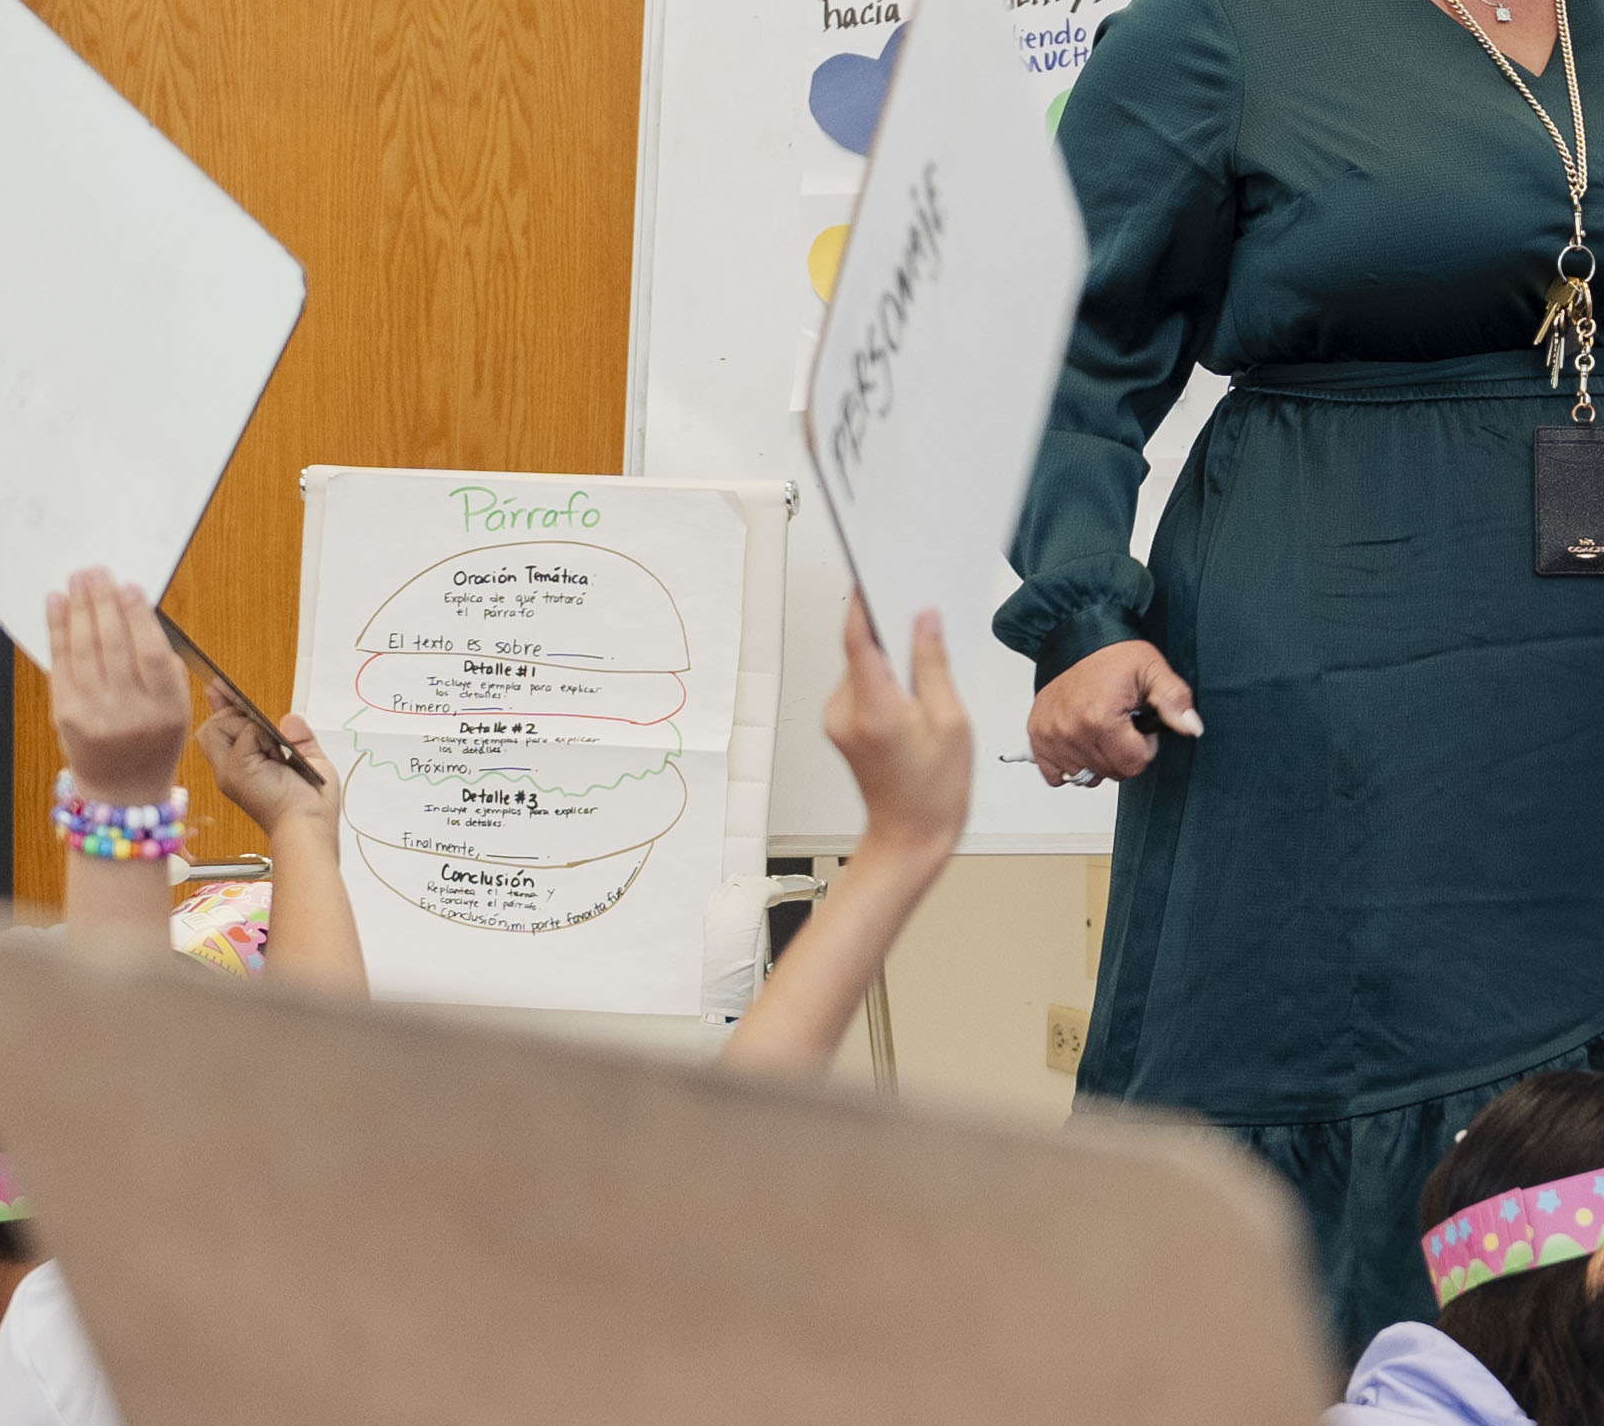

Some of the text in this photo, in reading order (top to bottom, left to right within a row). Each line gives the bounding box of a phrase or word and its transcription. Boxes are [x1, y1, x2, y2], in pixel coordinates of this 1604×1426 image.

[449, 485, 601, 533] Párrafo
[453, 567, 517, 587] Oración
[444, 592, 483, 607] Explica
[516, 590, 538, 610] qué
[484, 605, 534, 621] párrafo
[388, 634, 404, 650] El
[413, 634, 454, 652] texto
[495, 640, 542, 657] sobre
[464, 660, 512, 676] Detalle
[427, 675, 473, 690] Incluye
[560, 684, 603, 697] explicar
[511, 722, 539, 735] #2
[423, 734, 468, 746] Incluye
[461, 788, 539, 810] Detalle #3
[424, 803, 468, 816] Incluye
[555, 806, 599, 819] explicar
[441, 862, 535, 890] Conclusión
[530, 917, 562, 936] parte
